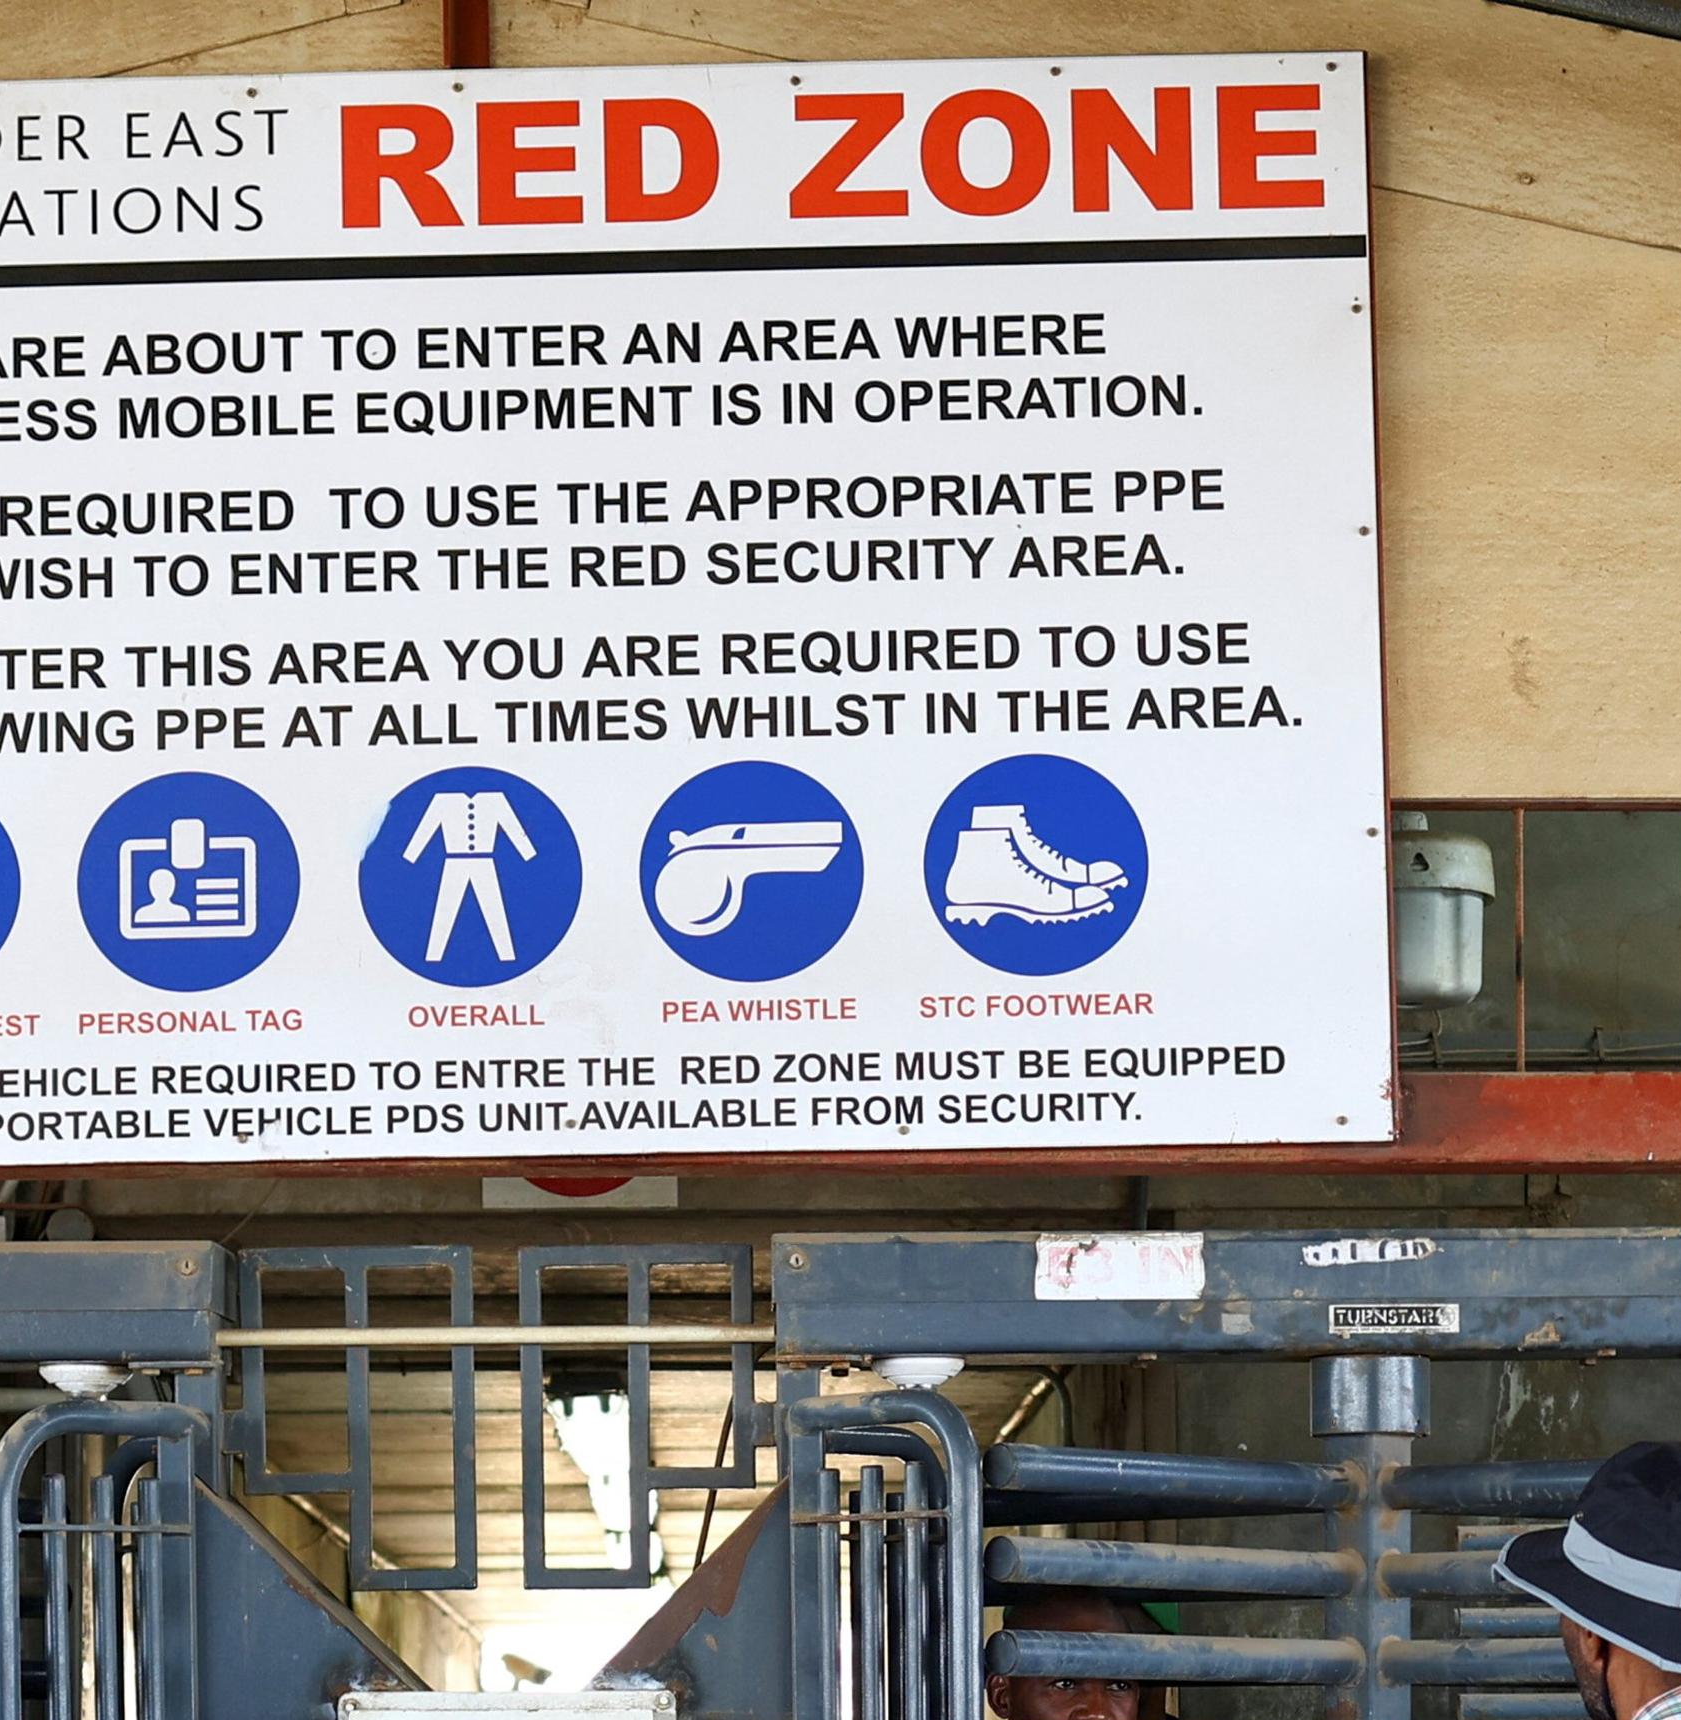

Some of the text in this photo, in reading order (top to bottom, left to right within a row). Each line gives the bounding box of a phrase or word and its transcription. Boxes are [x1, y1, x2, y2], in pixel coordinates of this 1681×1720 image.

[127, 109, 288, 158] EAST
[340, 83, 1326, 229] RED ZONE
[103, 331, 302, 376] ABOUT
[321, 329, 396, 370] TO
[418, 325, 607, 368] ENTER
[623, 322, 700, 364] AN
[719, 319, 880, 362] AREA
[895, 314, 1105, 358] WHERE
[120, 394, 334, 438] MOBILE
[357, 386, 692, 435] EQUIPMENT
[713, 384, 760, 425] IS
[783, 383, 832, 424] IN
[856, 375, 1202, 422] OPERATION.
[0, 491, 293, 537] REQUIRED
[330, 487, 404, 529] TO
[427, 485, 537, 527] USE
[558, 482, 668, 524] THE
[686, 472, 1093, 521] APPROPRIATE
[1116, 469, 1224, 512] PPE
[134, 555, 208, 596] TO
[231, 551, 419, 594] ENTER
[438, 548, 548, 590] THE
[572, 545, 685, 587] RED
[707, 538, 993, 584] SECURITY
[1009, 534, 1183, 577] AREA.
[125, 644, 251, 687] THIS
[269, 641, 429, 684] AREA
[444, 638, 562, 680] YOU
[582, 635, 699, 677] ARE
[723, 629, 1019, 676] REQUIRED
[1040, 626, 1115, 667] TO
[1137, 623, 1249, 666] USE
[158, 708, 265, 750] PPE
[283, 706, 352, 747] AT
[369, 704, 477, 745] ALL
[496, 699, 667, 742] TIMES
[687, 694, 905, 738] WHILST
[927, 693, 976, 733] IN
[998, 690, 1109, 732] THE
[1127, 686, 1301, 729] AREA.
[77, 1008, 304, 1035] PERSONAL TAG
[408, 1004, 546, 1028] OVERALL
[661, 997, 858, 1023] PEA WHISTLE
[919, 992, 1154, 1019] STC FOOTWEAR
[153, 1063, 355, 1095] REQUIRED
[370, 1062, 420, 1089] TO
[436, 1059, 564, 1088] ENTRE
[579, 1058, 654, 1086] THE
[682, 1056, 759, 1084] RED
[774, 1053, 880, 1082] ZONE
[897, 1051, 1004, 1080] MUST
[1020, 1050, 1069, 1078] BE
[1086, 1046, 1284, 1078] EQUIPPED
[204, 1107, 371, 1138] VEHICLE
[388, 1104, 463, 1133] PDS
[480, 1103, 568, 1132] UNIT
[579, 1097, 796, 1131] AVAILABLE
[812, 1096, 923, 1125] FROM
[939, 1092, 1143, 1124] SECURITY.
[1334, 1308, 1435, 1327] TURNSTAR
